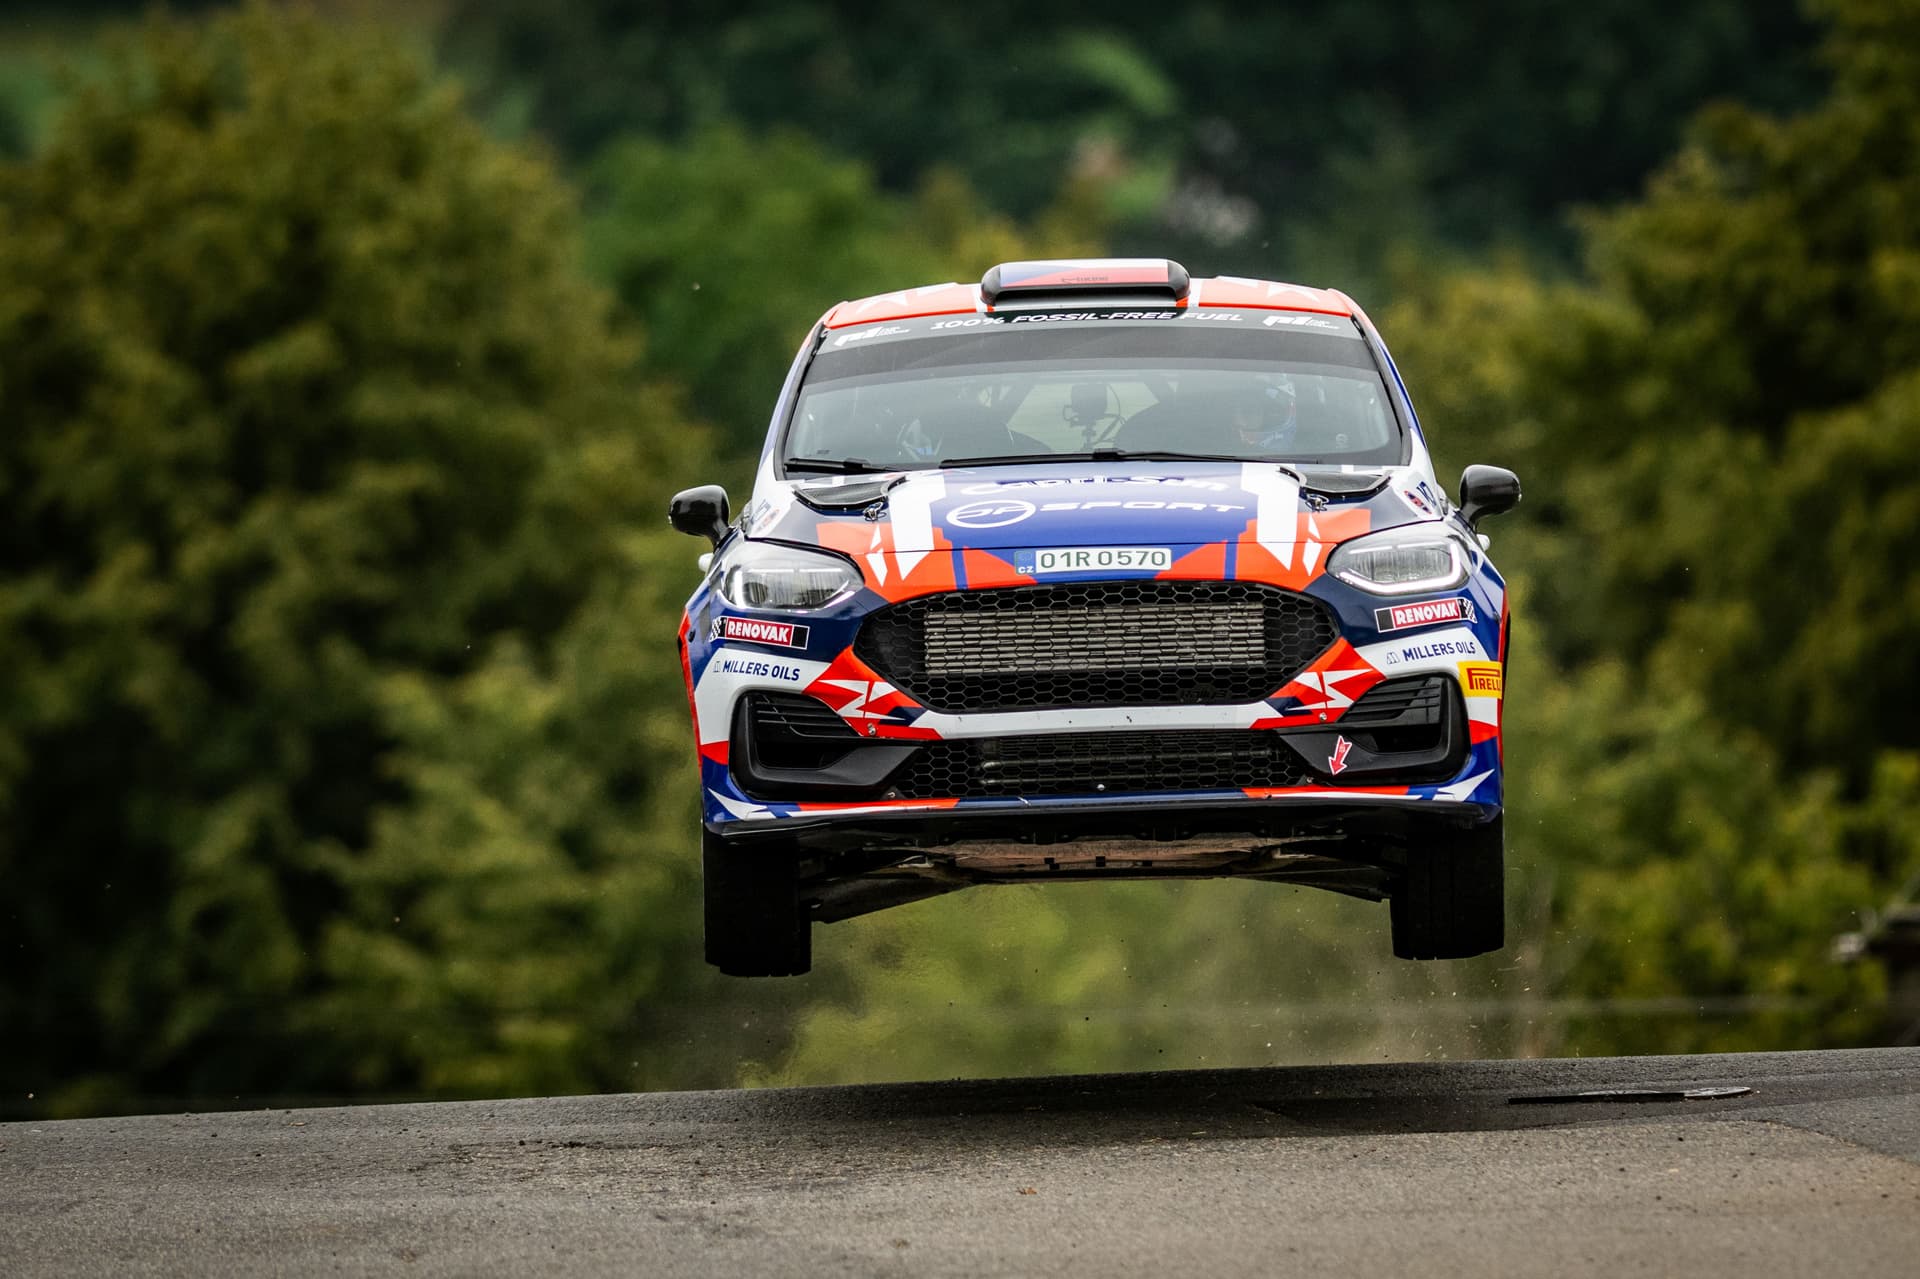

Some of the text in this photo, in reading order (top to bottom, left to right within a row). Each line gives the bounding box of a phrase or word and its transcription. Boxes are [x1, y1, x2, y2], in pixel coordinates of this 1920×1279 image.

[930, 312, 1244, 330] 100% FOSSIL-FREE FUEL
[1040, 501, 1245, 512] SPORT
[1040, 551, 1166, 568] 01R 0570
[1018, 566, 1034, 574] CZ
[1395, 602, 1458, 625] RENOVAK
[727, 621, 790, 642] RENOVAK
[1402, 642, 1476, 661] MILLERS OILS
[722, 660, 800, 681] MILLERS OILS
